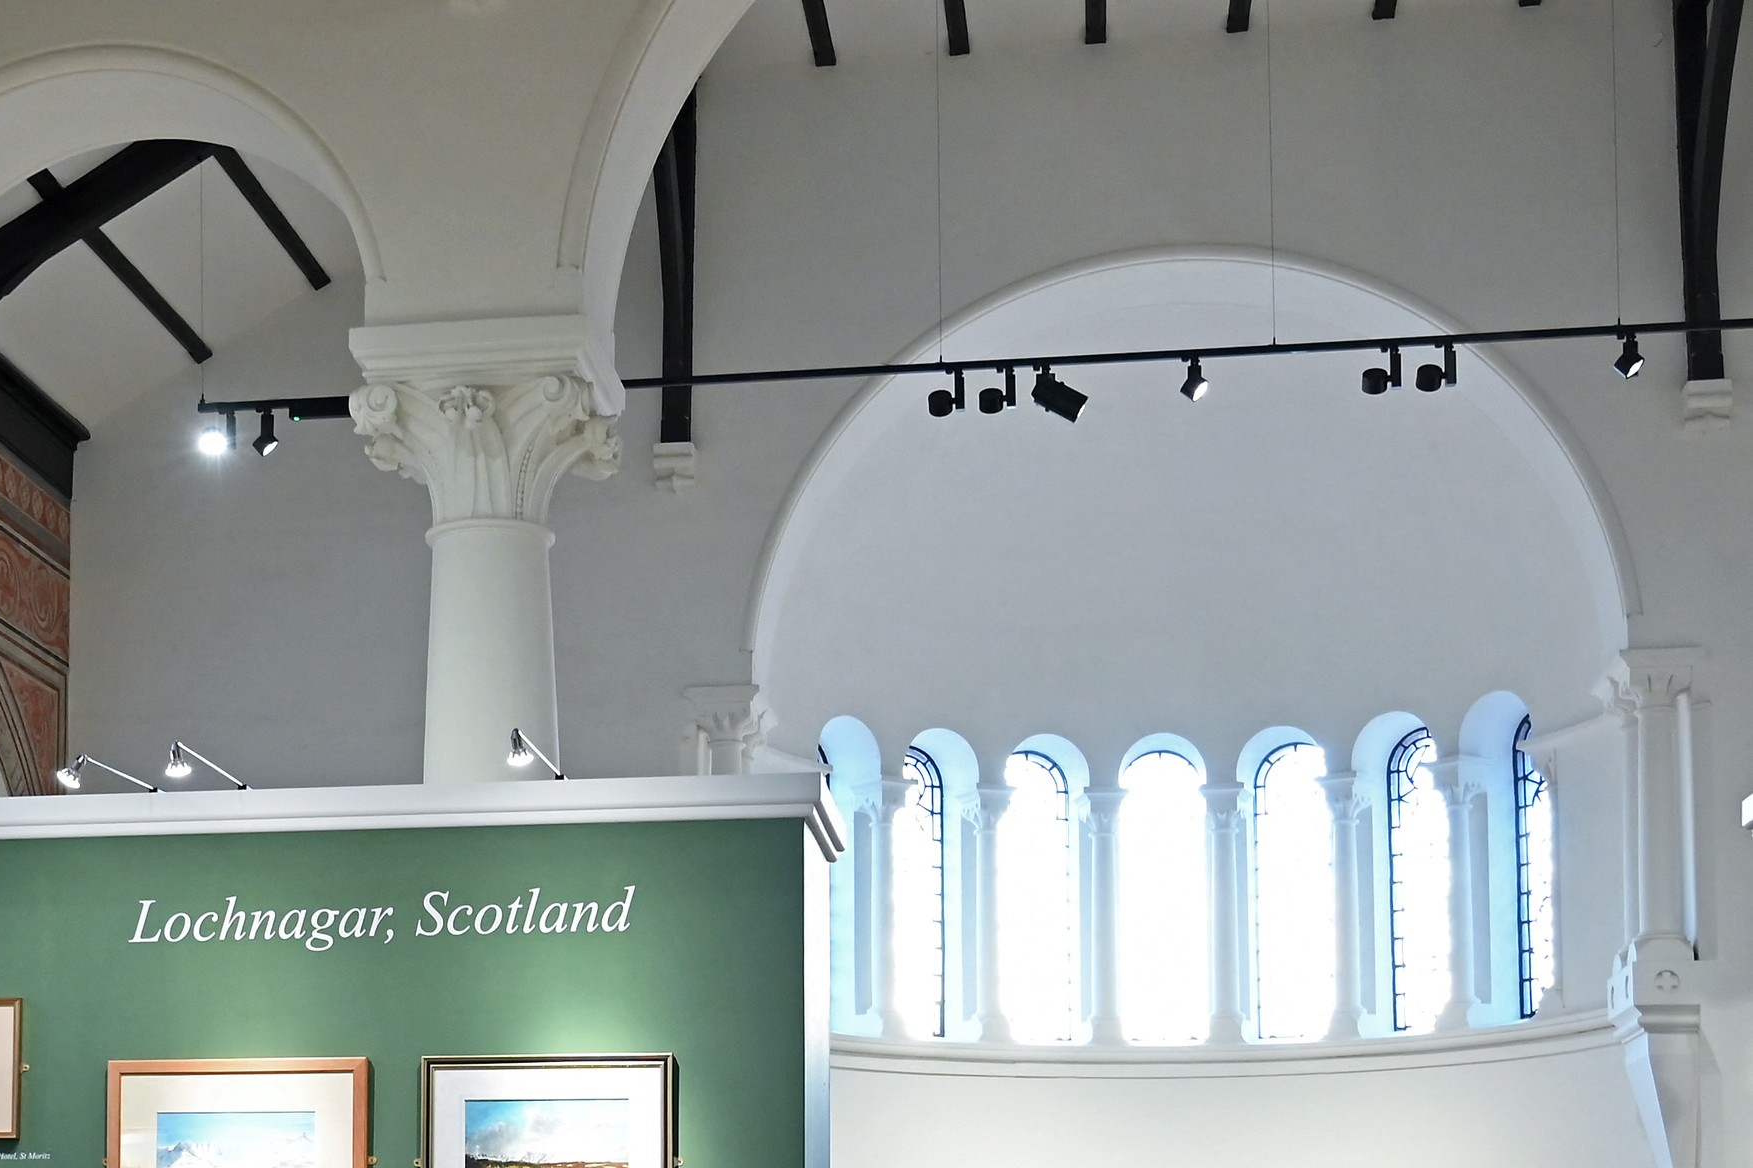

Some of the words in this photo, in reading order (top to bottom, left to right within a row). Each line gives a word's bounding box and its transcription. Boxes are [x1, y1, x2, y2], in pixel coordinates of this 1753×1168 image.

[128, 896, 394, 952] Lochnagar,
[415, 885, 636, 937] Scotland
[19, 1152, 27, 1160] St
[28, 1152, 51, 1160] Moritz
